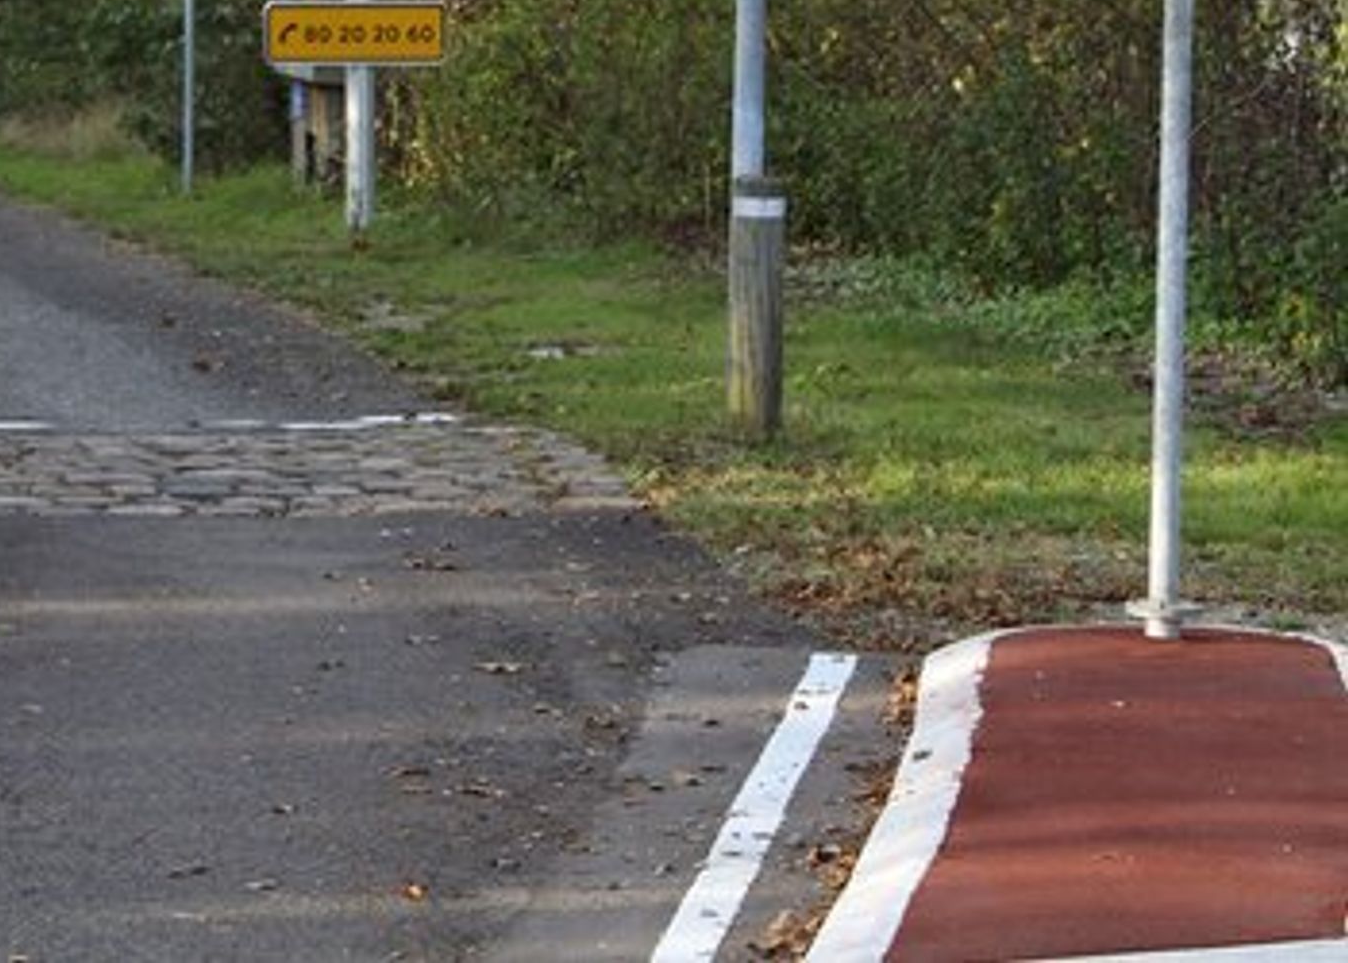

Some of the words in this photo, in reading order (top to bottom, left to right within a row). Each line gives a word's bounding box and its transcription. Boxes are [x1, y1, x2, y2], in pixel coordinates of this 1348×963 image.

[304, 24, 333, 44] 80
[338, 24, 366, 44] 20
[373, 24, 401, 44] 20
[406, 23, 436, 44] 60
